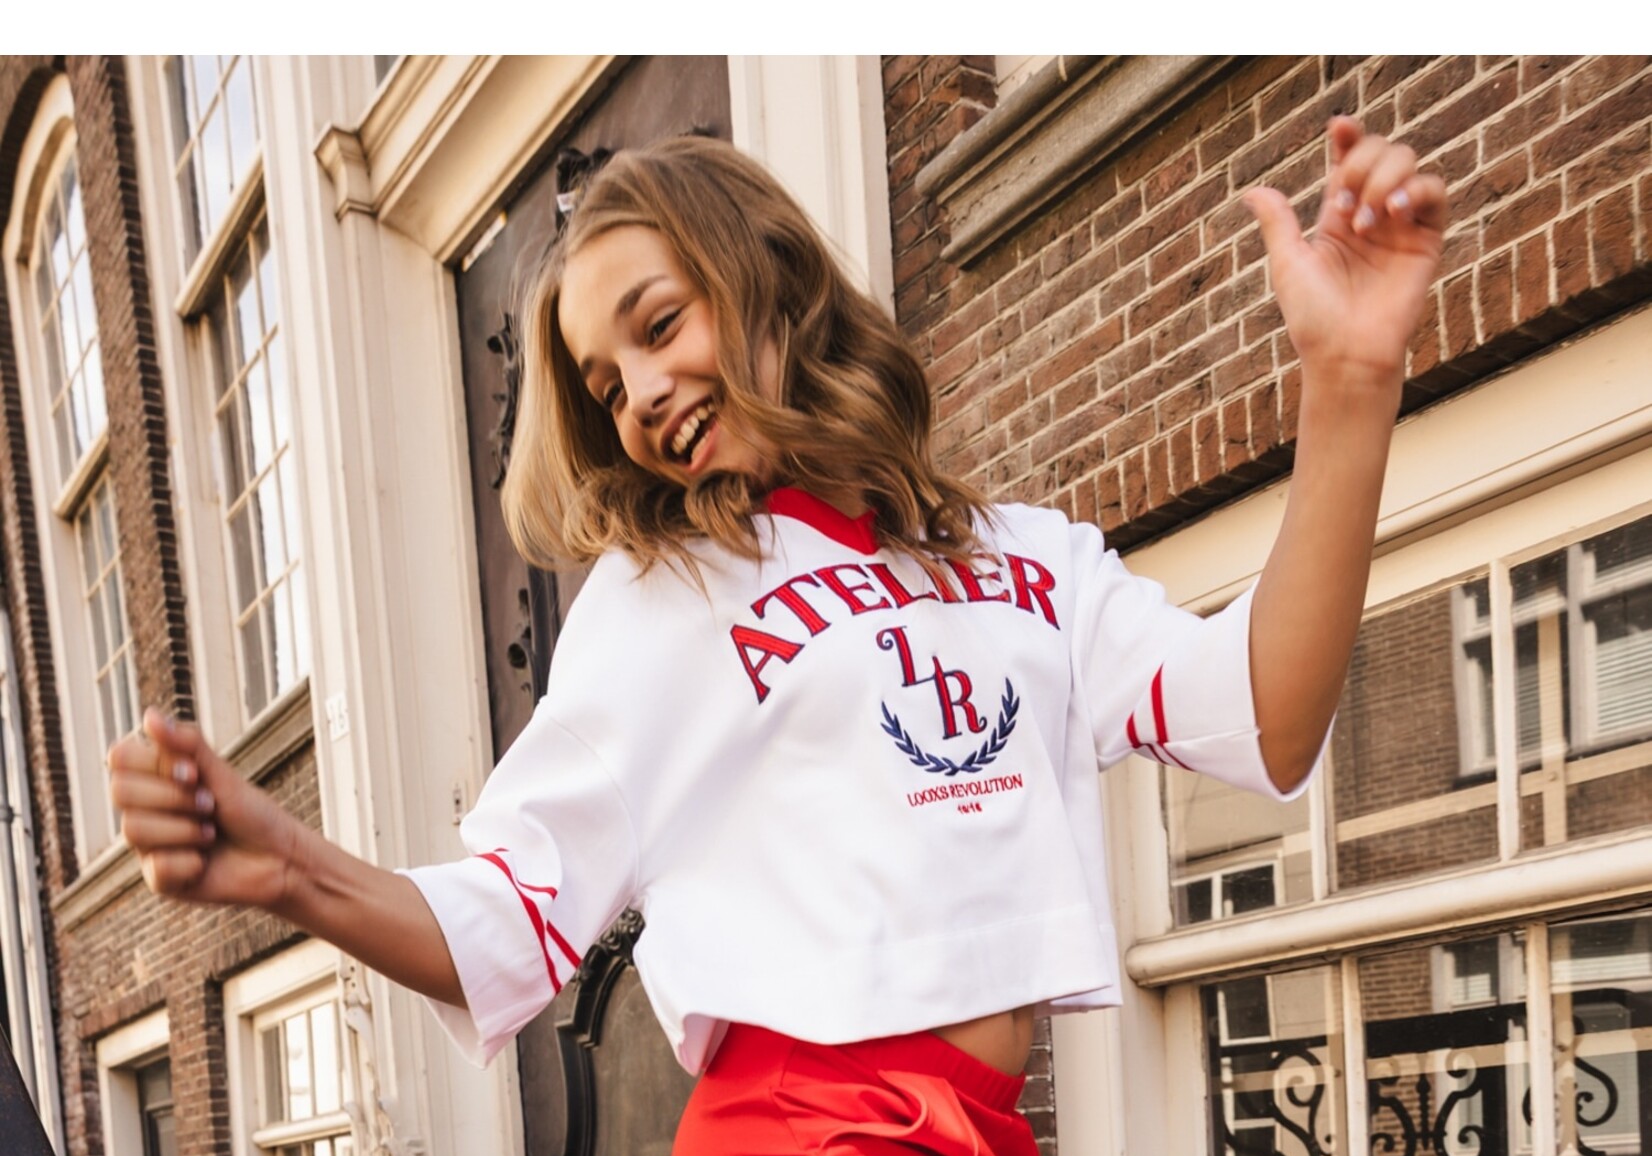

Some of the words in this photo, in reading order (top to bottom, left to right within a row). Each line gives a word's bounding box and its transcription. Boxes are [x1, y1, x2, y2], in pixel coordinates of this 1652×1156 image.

[730, 552, 1061, 705] ATELIER
[907, 785, 949, 807] LOOXS
[949, 774, 1023, 798] REVOLUTION
